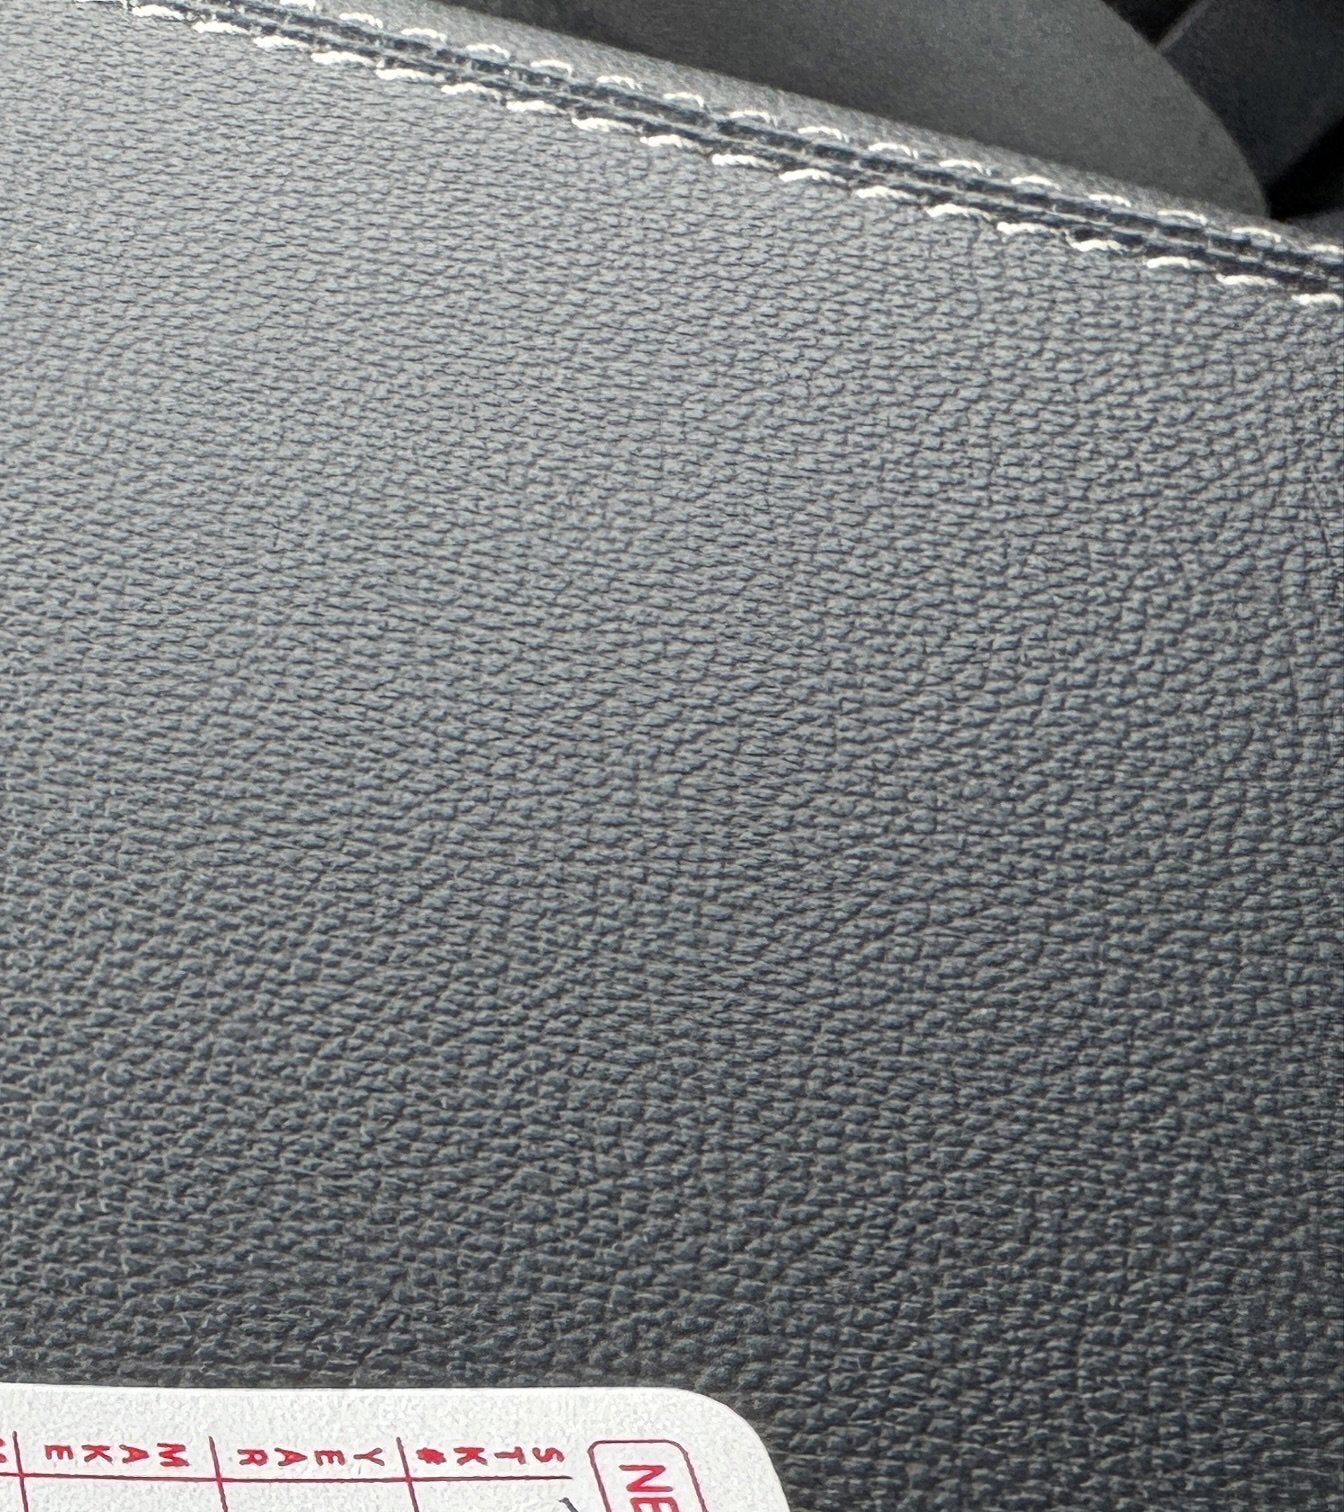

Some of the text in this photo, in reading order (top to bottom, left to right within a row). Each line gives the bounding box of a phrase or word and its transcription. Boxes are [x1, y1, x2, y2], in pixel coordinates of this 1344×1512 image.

[45, 1441, 192, 1468] MAKE
[237, 1446, 383, 1467] YEAR
[416, 1445, 565, 1467] STK#
